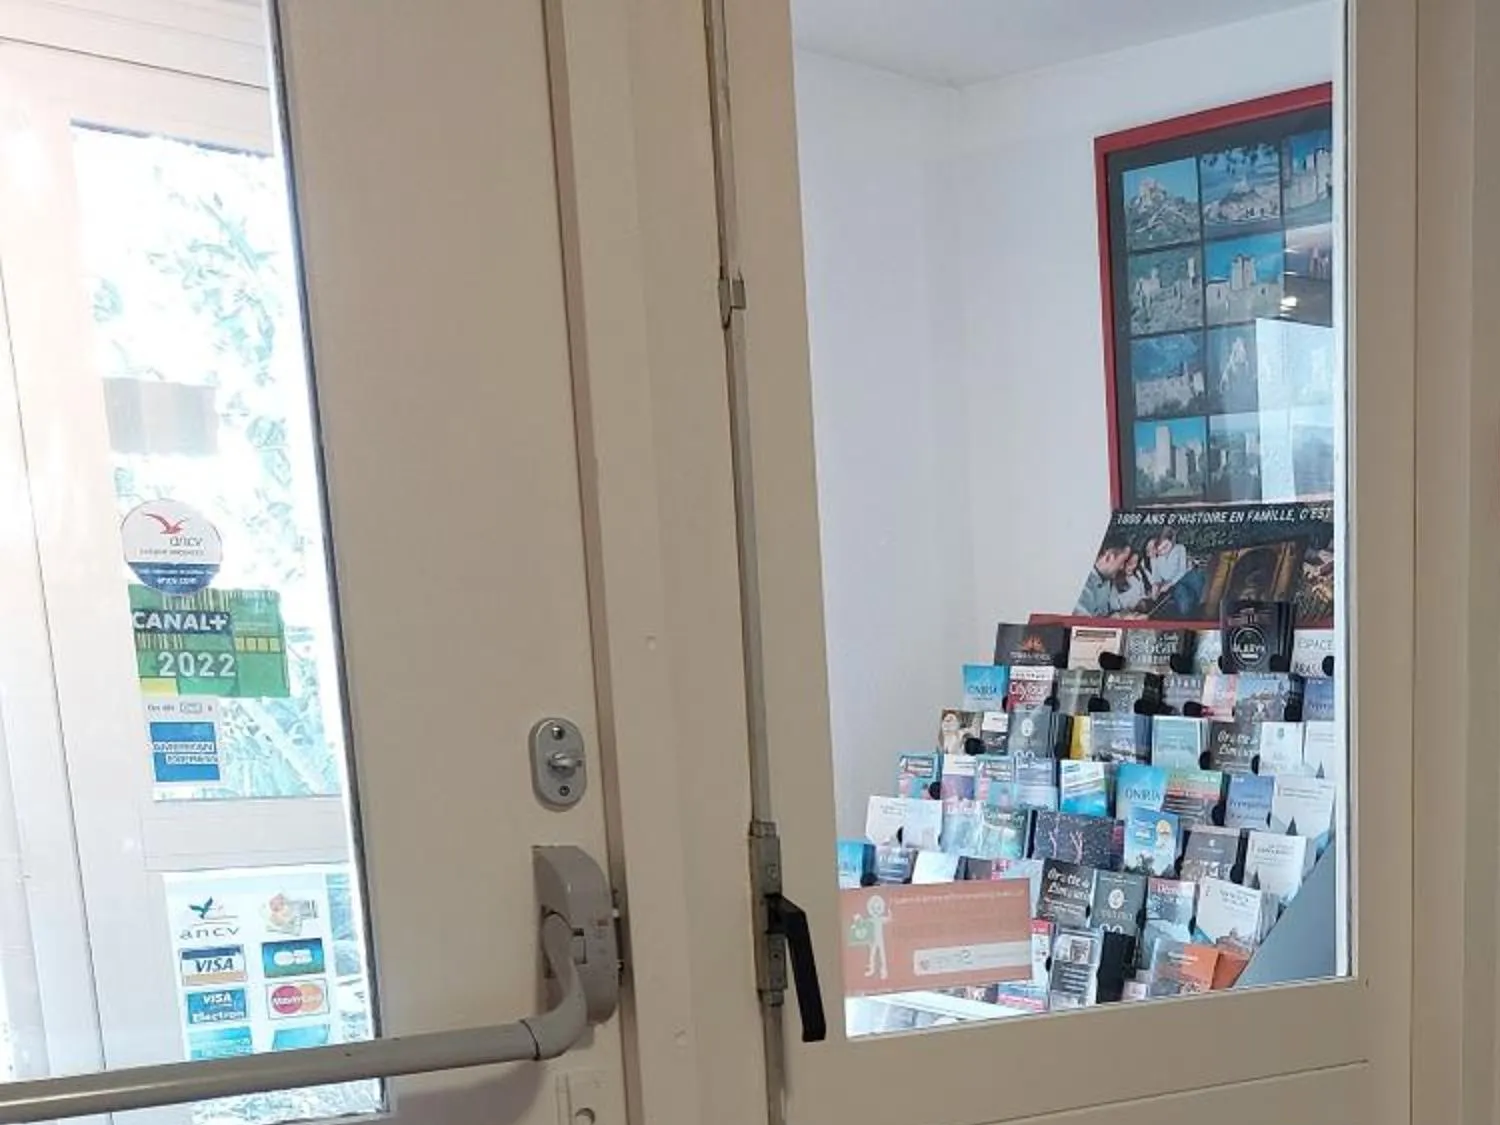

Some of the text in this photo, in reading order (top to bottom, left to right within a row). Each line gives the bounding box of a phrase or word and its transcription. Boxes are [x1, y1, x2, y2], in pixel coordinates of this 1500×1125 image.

[1143, 512, 1165, 525] ANS
[1229, 510, 1245, 523] EN
[132, 612, 228, 631] CANAL+
[158, 651, 237, 677] 2022
[180, 927, 240, 940] ancv
[194, 957, 234, 973] VISA
[203, 992, 233, 1005] VISA
[192, 1011, 246, 1023] Electron
